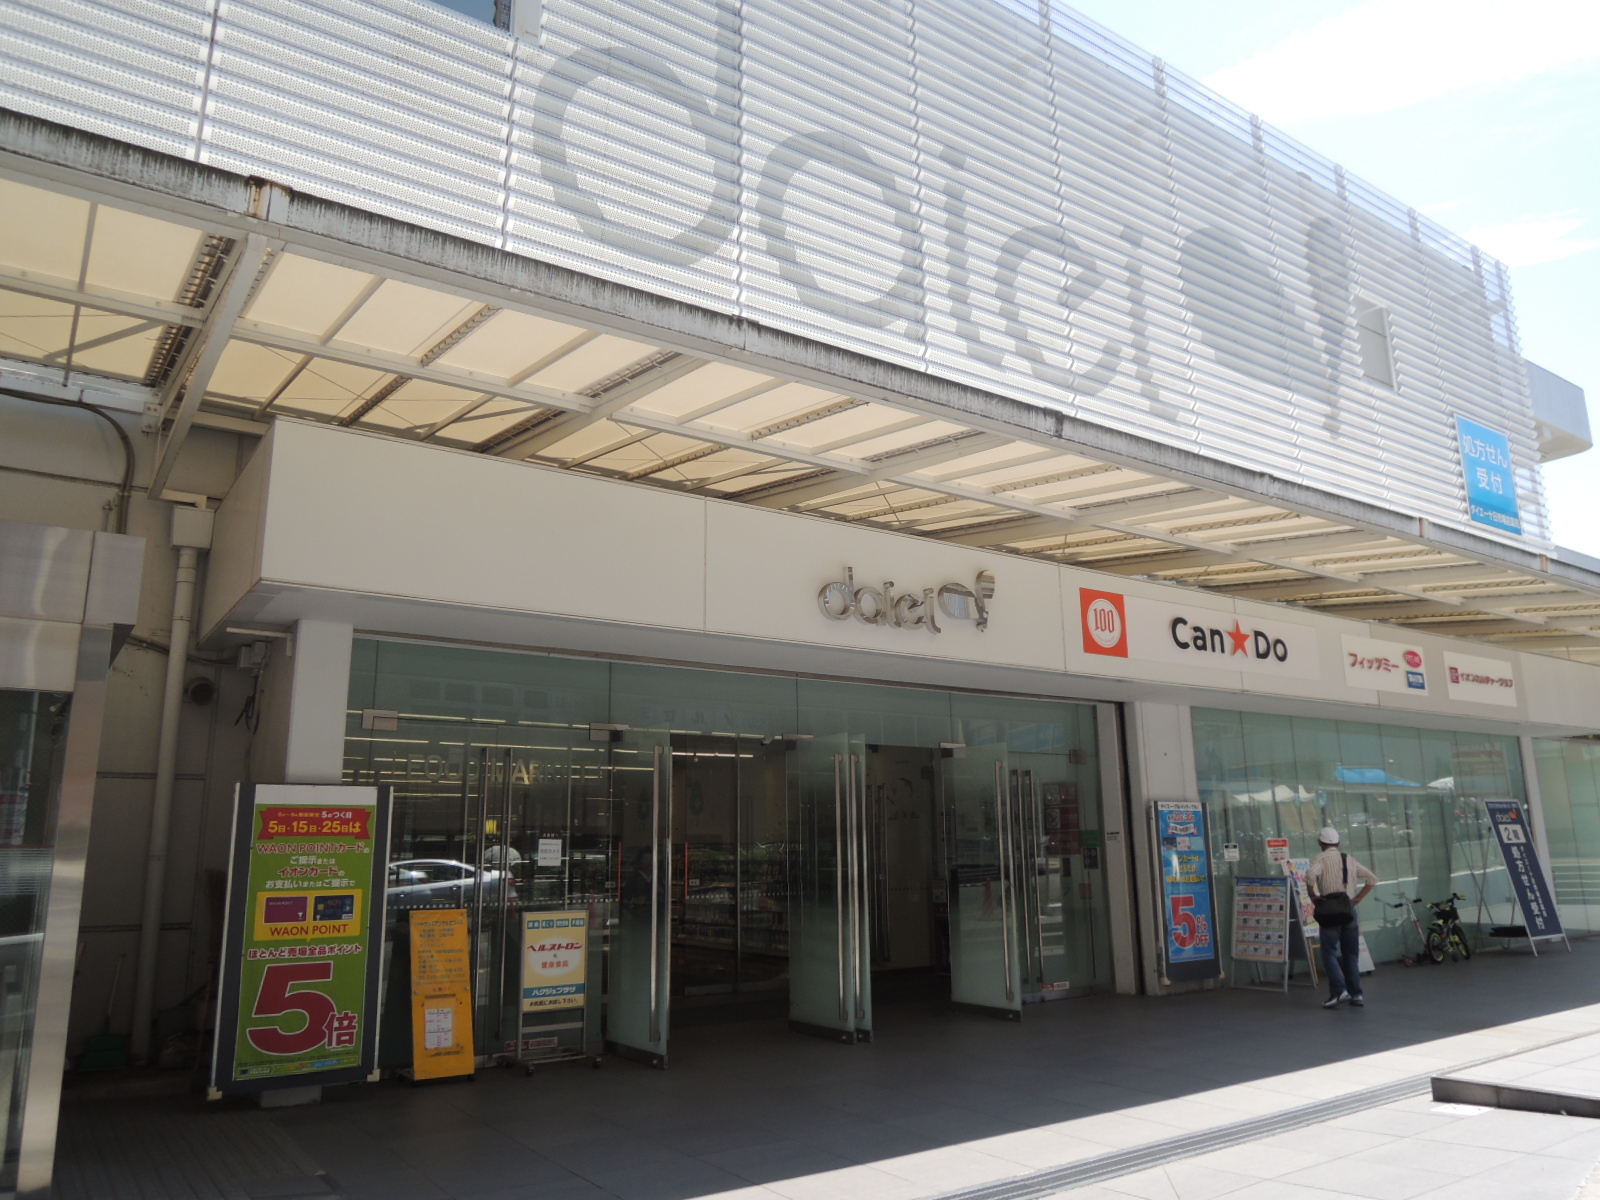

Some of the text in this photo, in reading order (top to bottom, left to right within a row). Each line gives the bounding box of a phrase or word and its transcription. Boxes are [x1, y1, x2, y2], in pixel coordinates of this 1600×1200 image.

[1463, 433, 1508, 469] 処方せん
[1476, 467, 1504, 495] 受付
[818, 566, 942, 635] daiei
[1093, 607, 1116, 634] 100
[1171, 617, 1288, 663] Can Do
[321, 810, 352, 819] 5のつく日
[268, 820, 361, 833] 5日・15日・25日は
[256, 843, 297, 854] WAON
[278, 866, 345, 877] イオンカードの
[1170, 895, 1197, 949] 5
[270, 924, 349, 936] WAON POINT
[527, 942, 583, 952] ヘルストロン
[1195, 934, 1210, 947] OFF
[248, 944, 362, 960] ほとんど売場全品ポイント
